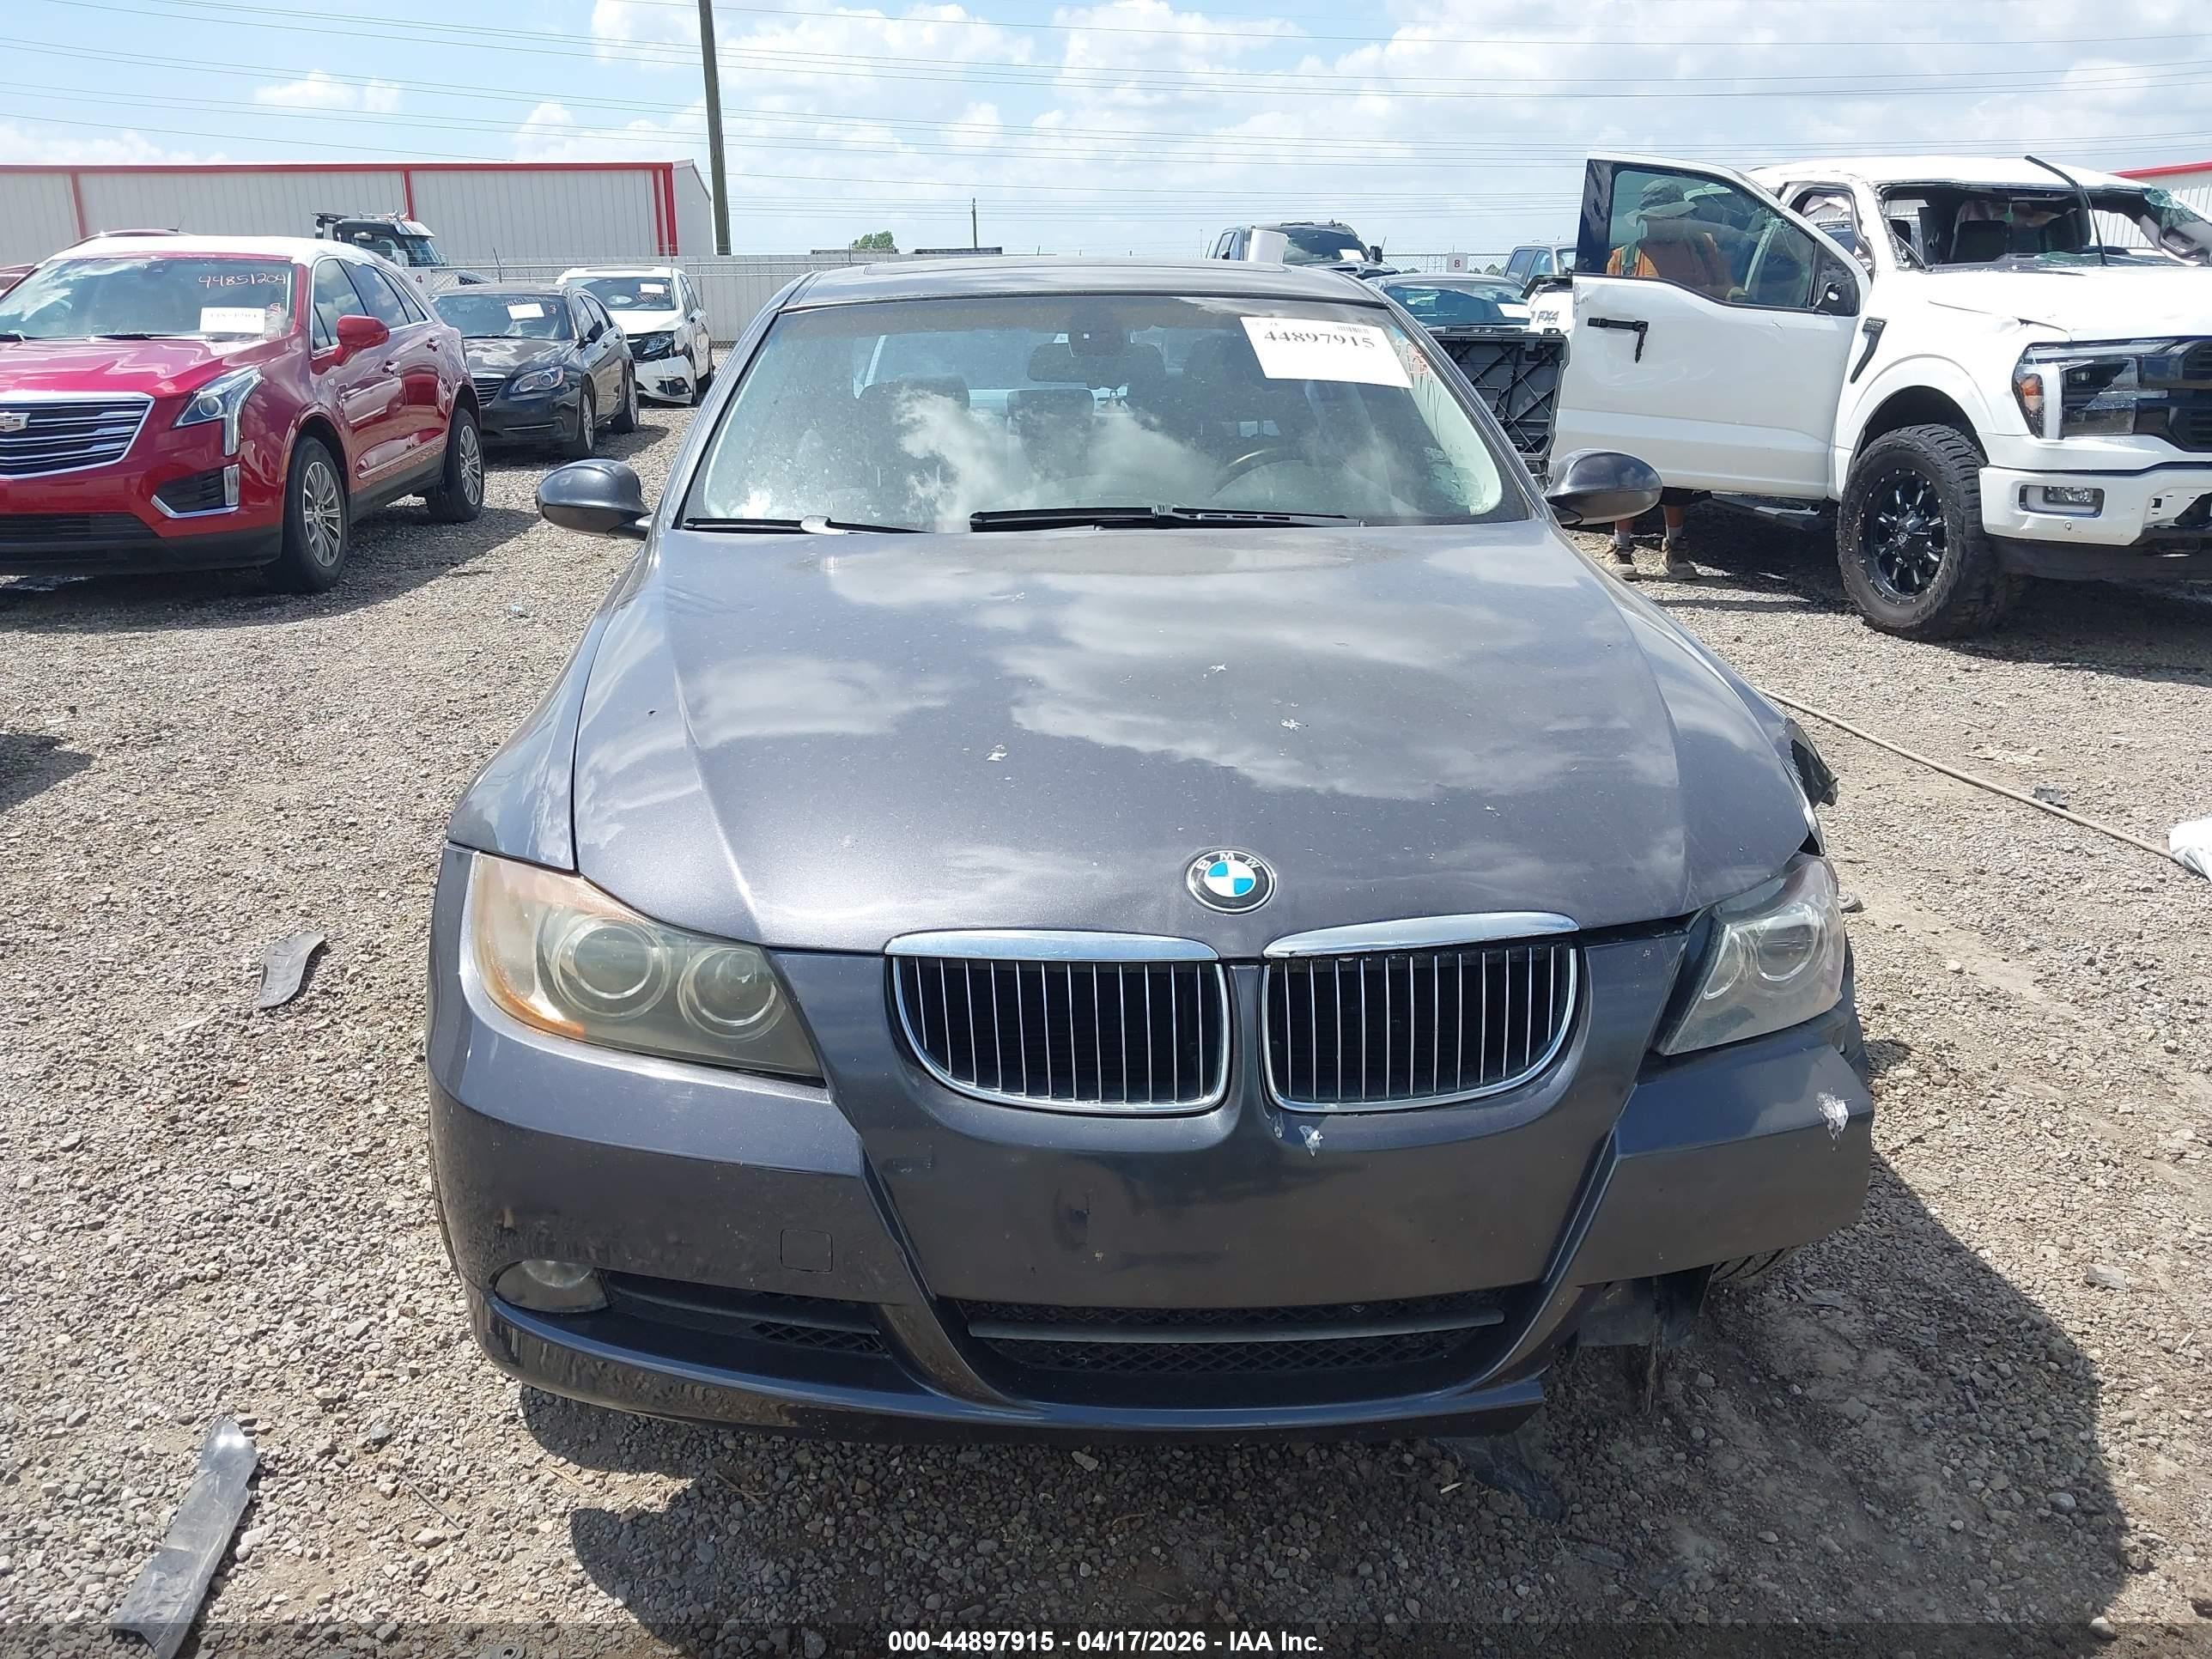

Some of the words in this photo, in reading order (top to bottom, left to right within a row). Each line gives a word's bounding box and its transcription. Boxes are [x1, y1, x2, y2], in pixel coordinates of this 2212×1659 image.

[1454, 259, 1461, 268] 8
[198, 273, 286, 289] 44851204
[416, 275, 423, 283] 4
[1536, 310, 1559, 323] FX4
[1264, 331, 1375, 348] 44897915
[1195, 853, 1261, 871] BMW
